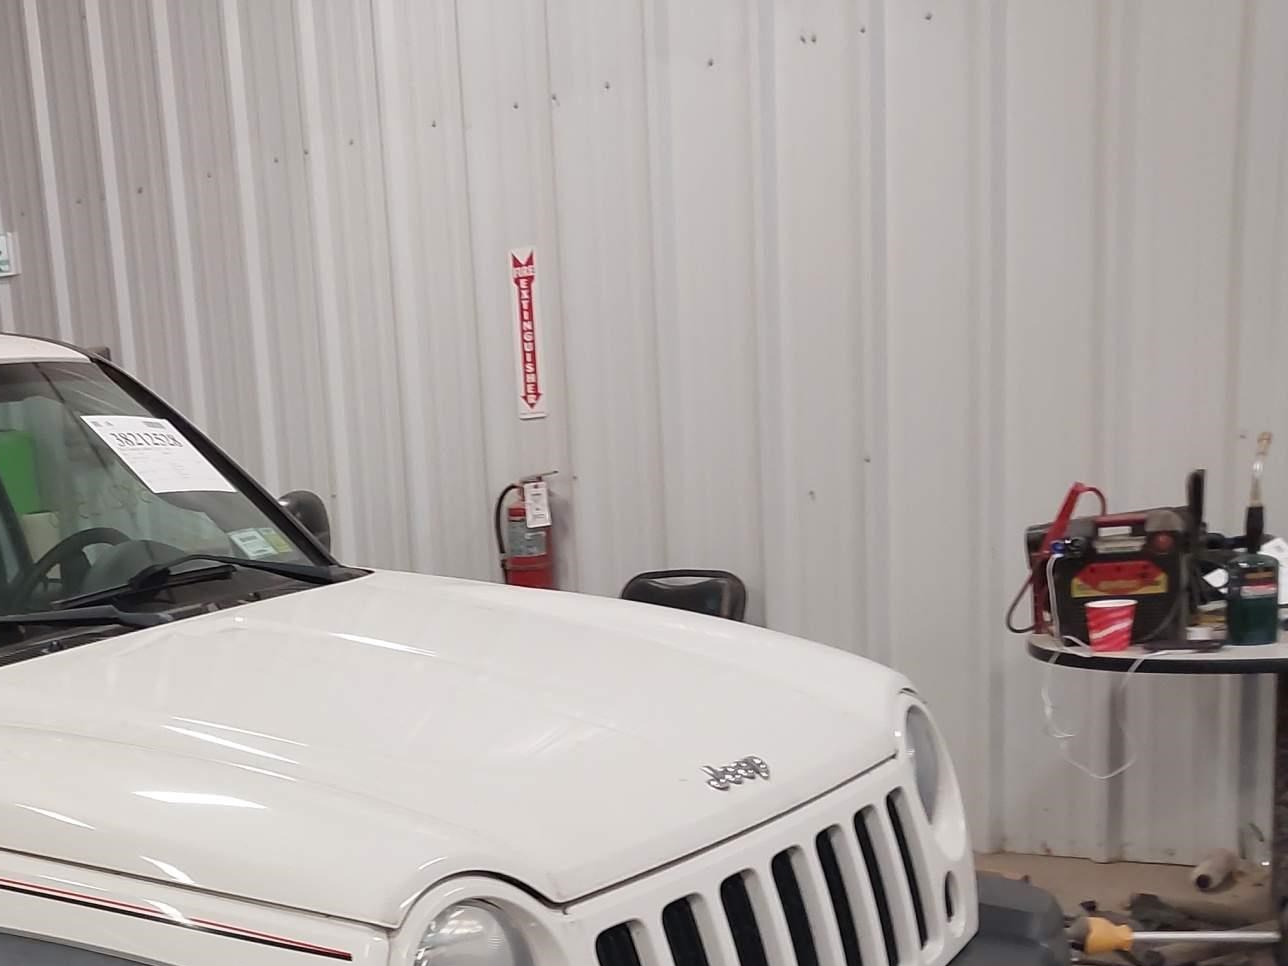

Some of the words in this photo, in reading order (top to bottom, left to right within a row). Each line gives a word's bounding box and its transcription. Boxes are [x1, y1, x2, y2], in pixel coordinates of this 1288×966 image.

[519, 278, 537, 404] EXTINGUISHER
[110, 432, 184, 447] 38212528
[702, 755, 770, 791] Jeep
